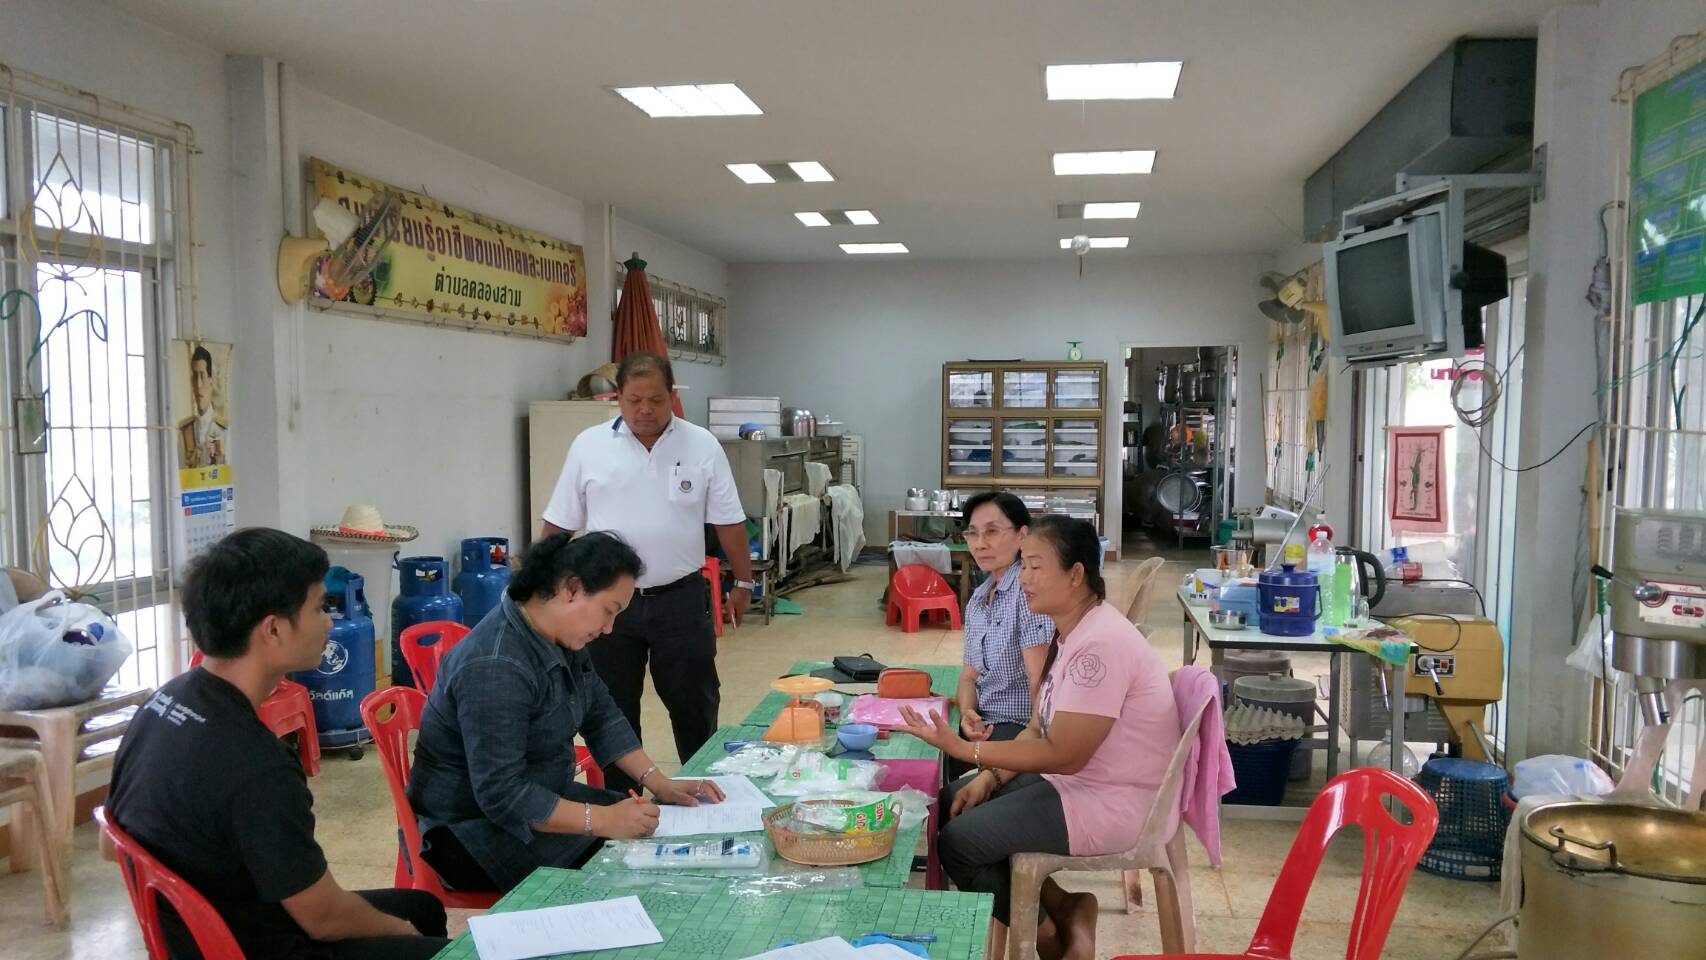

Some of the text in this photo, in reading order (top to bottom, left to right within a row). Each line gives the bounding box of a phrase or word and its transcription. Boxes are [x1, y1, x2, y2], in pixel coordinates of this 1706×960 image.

[434, 266, 522, 307] ตำบลคลองสาม
